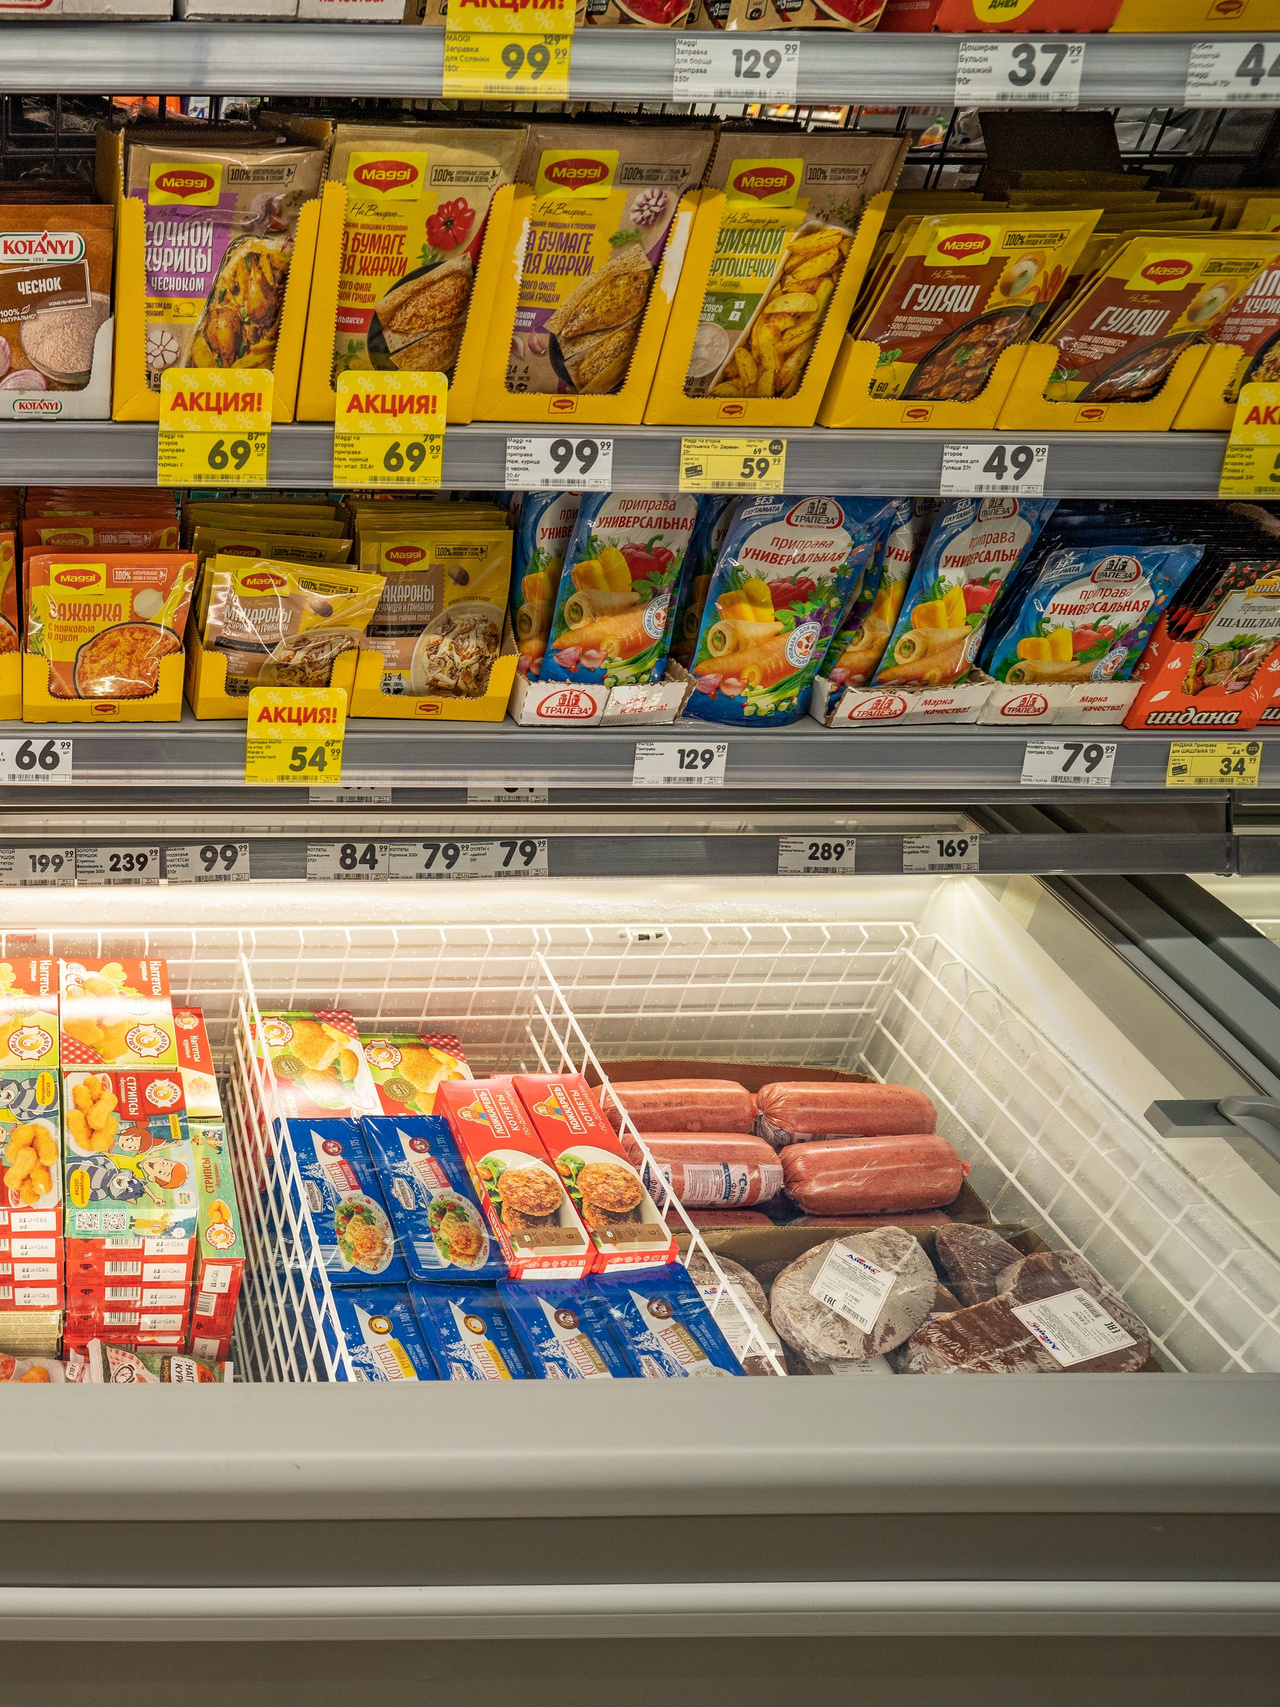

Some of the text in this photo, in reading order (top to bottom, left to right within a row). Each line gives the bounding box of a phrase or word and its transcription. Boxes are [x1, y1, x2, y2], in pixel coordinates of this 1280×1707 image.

[961, 43, 998, 52] Доширак
[501, 44, 550, 80] 99
[690, 58, 712, 66] борща
[732, 44, 798, 79] 129 99
[960, 55, 988, 63] Бульон
[1008, 44, 1068, 86] 37
[958, 66, 992, 74] говяжий
[162, 178, 208, 189] Maggi
[230, 169, 250, 181] 100%
[362, 169, 411, 182] Maggi
[741, 176, 788, 188] Maggi
[146, 219, 214, 247] СОЧНОЙ
[352, 232, 406, 255] БУМАГЕ
[944, 239, 985, 250] Maggi
[358, 257, 408, 277] ЖАРКИ
[18, 277, 62, 296] ЧЕСНОК
[152, 278, 204, 292] ЧЕСНОКОМ
[901, 284, 980, 312] ГУЛЯШ
[0, 308, 20, 318] 100%
[170, 392, 262, 415] АКЦИЯ!
[346, 394, 437, 417] АКЦИЯ!
[208, 440, 250, 470] 69
[384, 442, 427, 473] 69
[550, 439, 598, 474] 99
[982, 446, 1046, 480] 49 99
[740, 458, 770, 479] 59
[618, 499, 676, 512] приправа
[596, 516, 694, 532] УНИВЕРСАЛЬНАЯ
[794, 515, 836, 524] ТРАПЕЗА
[770, 537, 834, 549] приправа
[743, 549, 844, 565] УНИВЕРСАЛЬНАЯ
[60, 575, 96, 584] Maggi
[246, 578, 282, 586] Maggi
[1096, 570, 1134, 579] ТРАПЕЗА
[50, 602, 122, 622] ЗАЖАРКА
[225, 606, 292, 624] МАКАРОНЫ
[54, 624, 94, 634] МОРКОВЬЮ
[923, 698, 954, 706] Марка
[923, 706, 970, 716] качества!
[257, 706, 336, 726] АКЦИЯ!
[1146, 710, 1240, 725] индана
[16, 740, 60, 770] 66
[289, 746, 327, 772] 54
[678, 749, 714, 770] 129
[1062, 744, 1104, 773] 79
[1220, 758, 1246, 775] 34
[340, 844, 378, 870] 84
[422, 844, 460, 869] 79
[500, 840, 538, 868] 79
[808, 842, 845, 861] 289
[937, 839, 969, 857] 169
[29, 854, 64, 873] 199
[109, 853, 148, 872] 239
[200, 844, 238, 872] 99
[149, 960, 162, 996] Наггетсы
[128, 1076, 138, 1116] СТРИПСЫ
[497, 1094, 520, 1132] КОТЛЕТЫ
